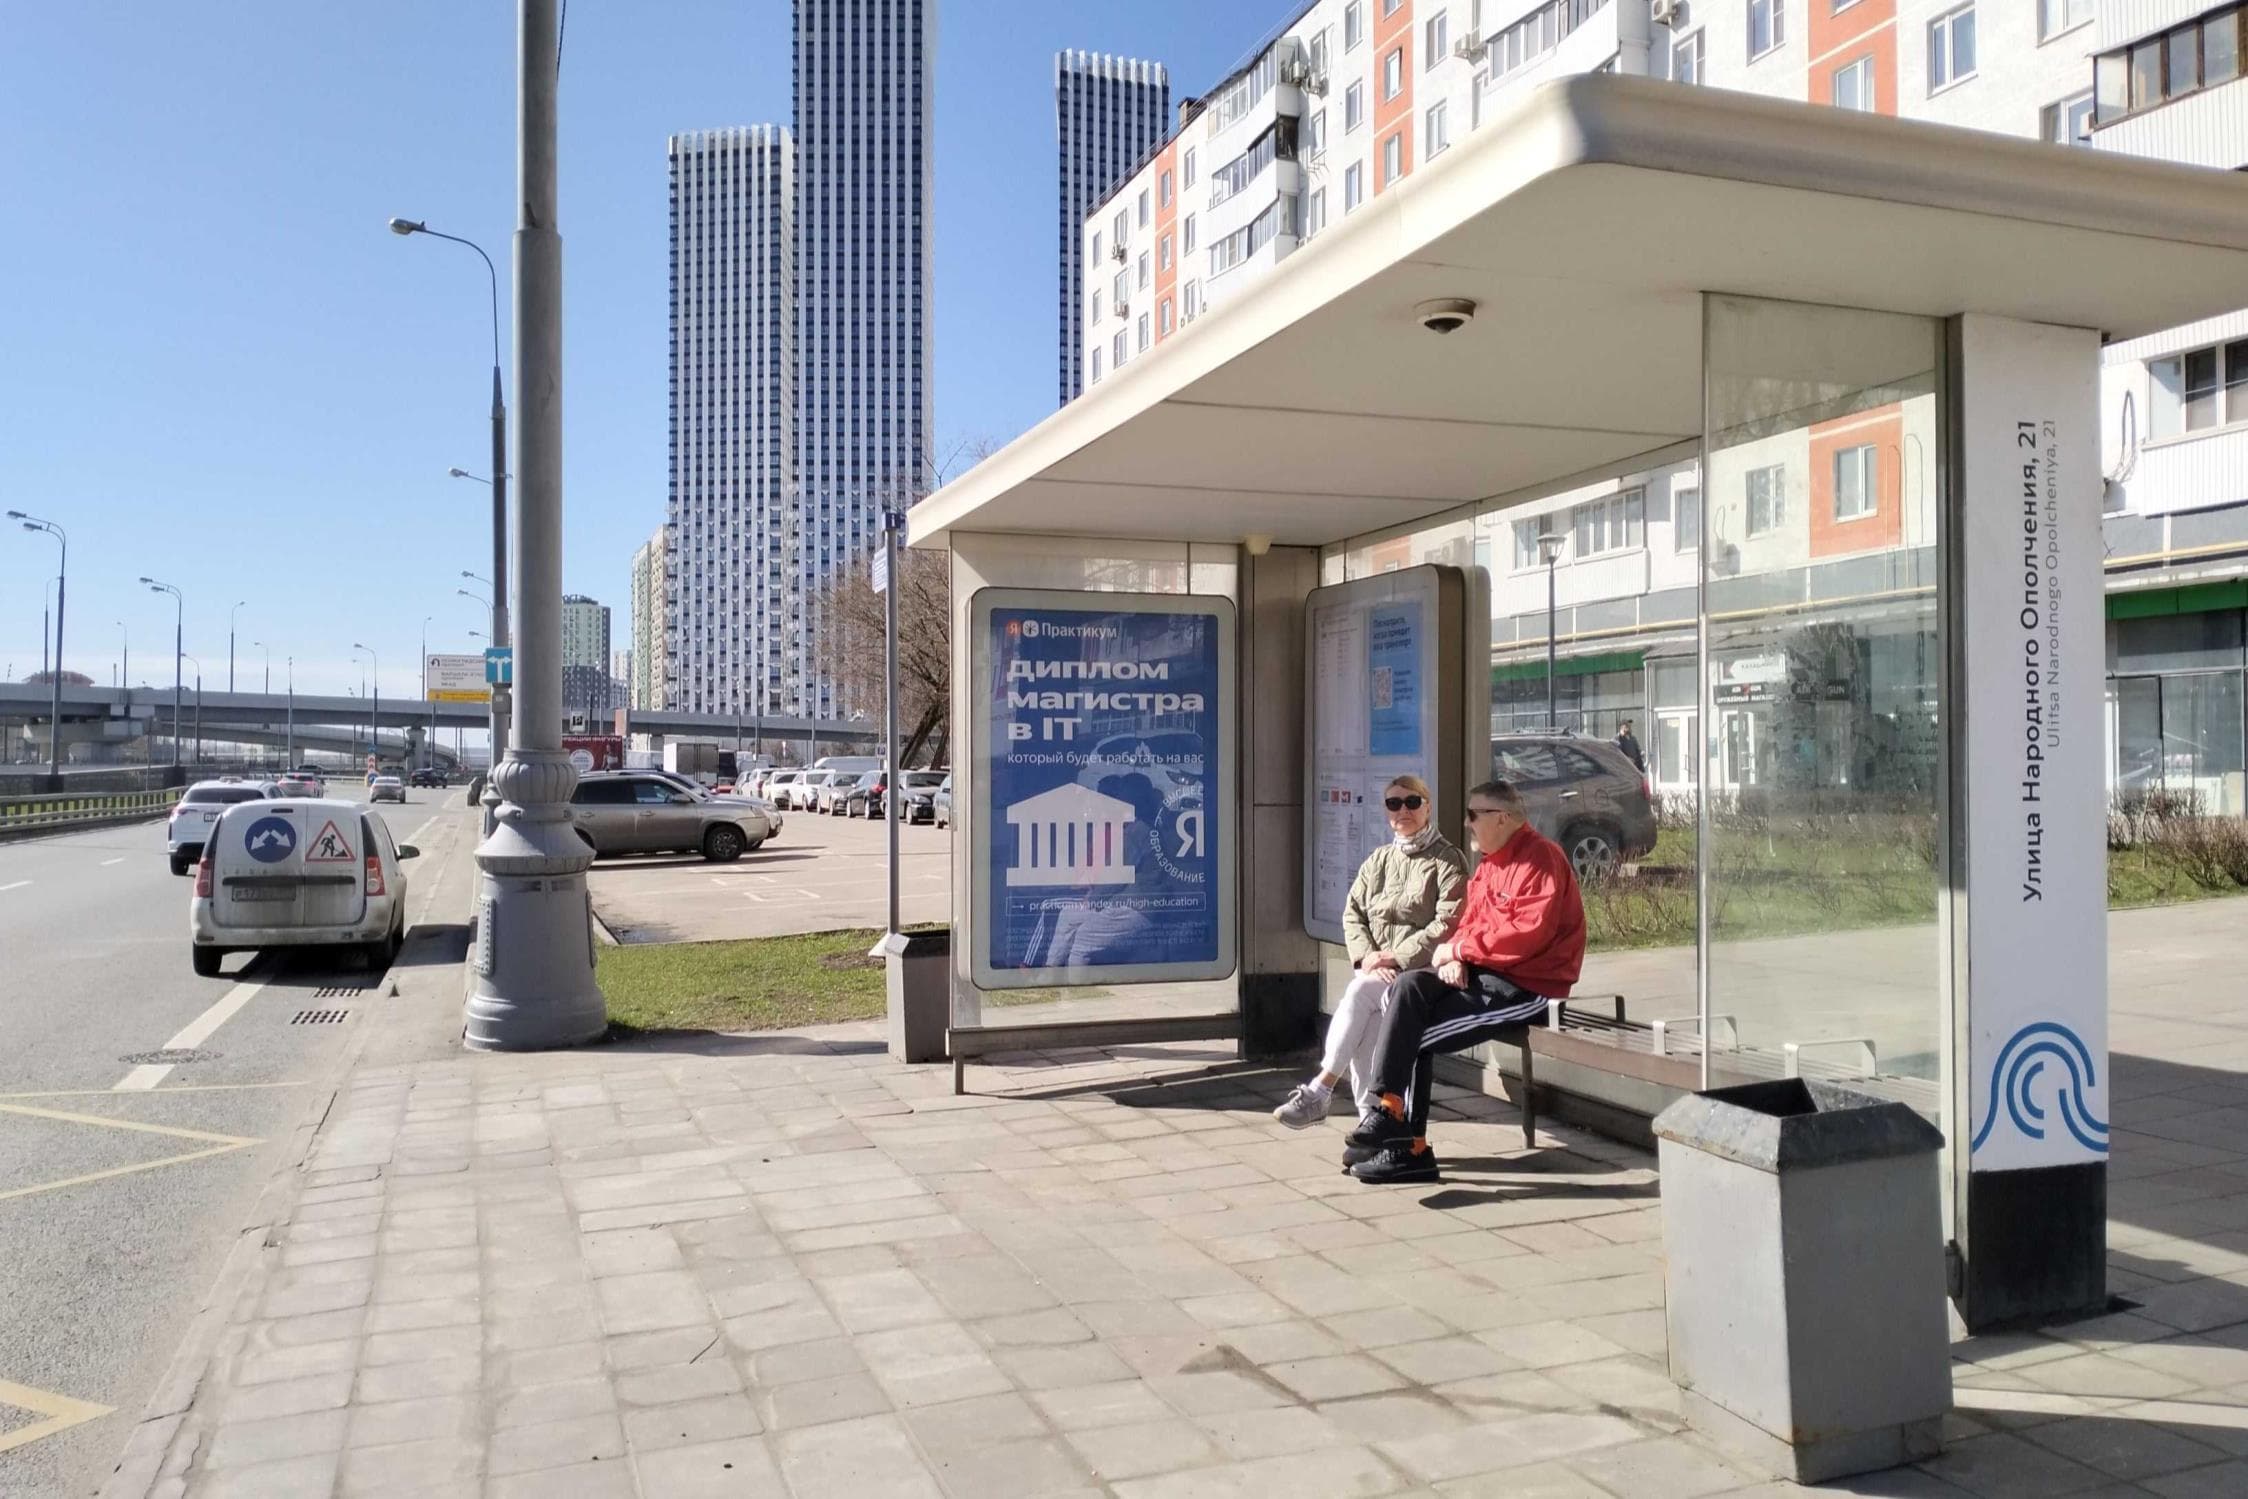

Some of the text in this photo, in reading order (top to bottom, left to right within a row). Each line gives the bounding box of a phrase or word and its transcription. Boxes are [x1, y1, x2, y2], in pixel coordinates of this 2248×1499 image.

[2042, 419, 2062, 748] Ulitsa Narodnogo Opolcheniya, 21
[1041, 622, 1118, 640] Практикум
[2017, 420, 2044, 902] Улица Народного Ополчения, 21
[1826, 684, 1846, 695] GUN
[1007, 691, 1205, 716] магистра
[1007, 717, 1083, 741] в IT
[1007, 750, 1204, 766] который будет работать на вас
[1175, 810, 1205, 858] Я
[1150, 829, 1206, 883] ОБРАЗОВАНИЕ
